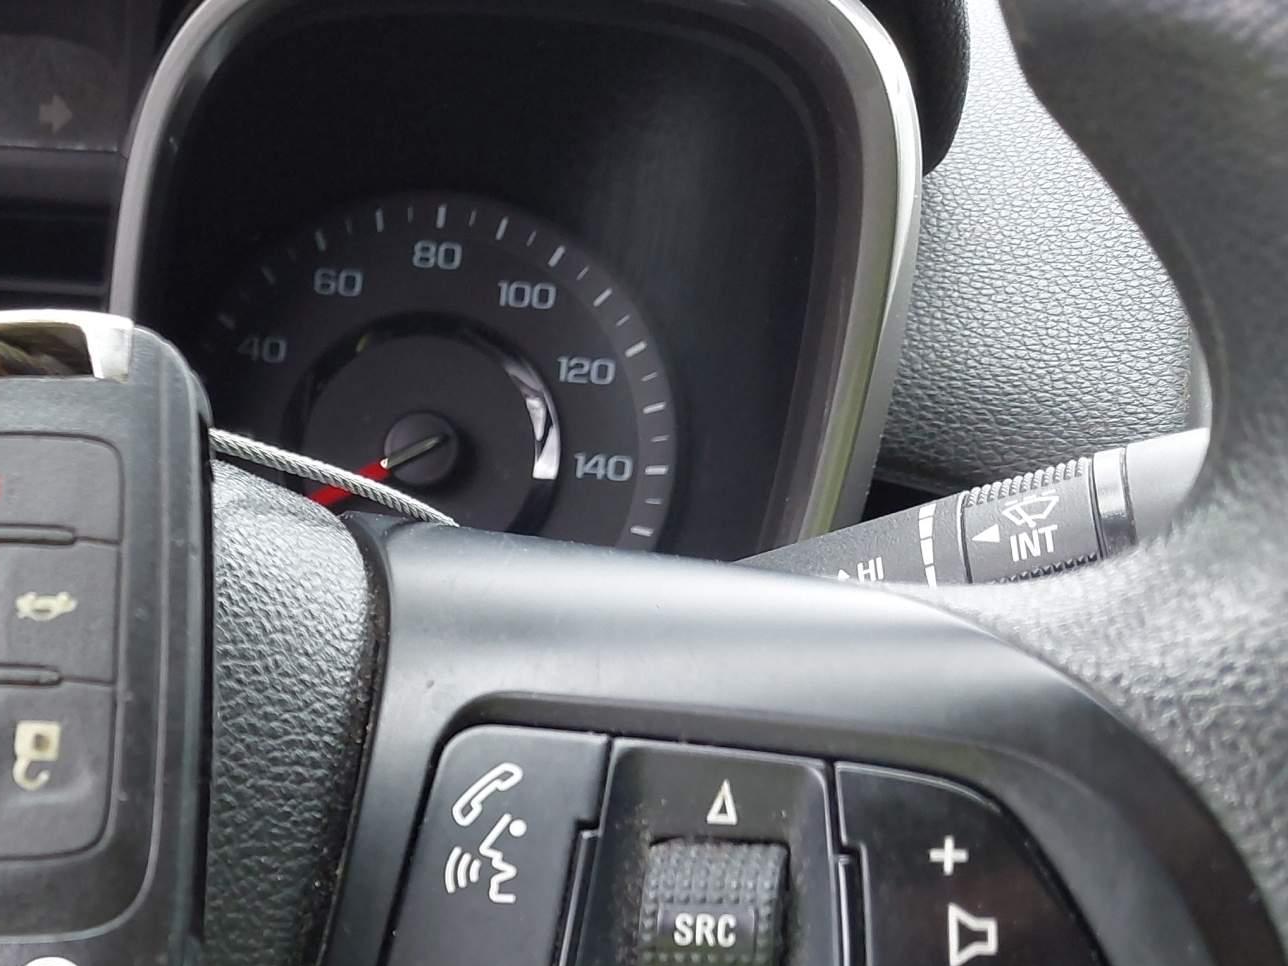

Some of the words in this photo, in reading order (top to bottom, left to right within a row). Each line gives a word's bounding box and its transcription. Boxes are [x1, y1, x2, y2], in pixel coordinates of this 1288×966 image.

[413, 241, 463, 270] 80
[314, 270, 363, 297] 60
[497, 281, 557, 309] 100
[238, 337, 287, 364] 40
[557, 356, 616, 385] 120
[575, 453, 633, 481] 140
[1009, 524, 1059, 562] INT
[856, 557, 885, 582] HI
[674, 912, 737, 948] SRC
